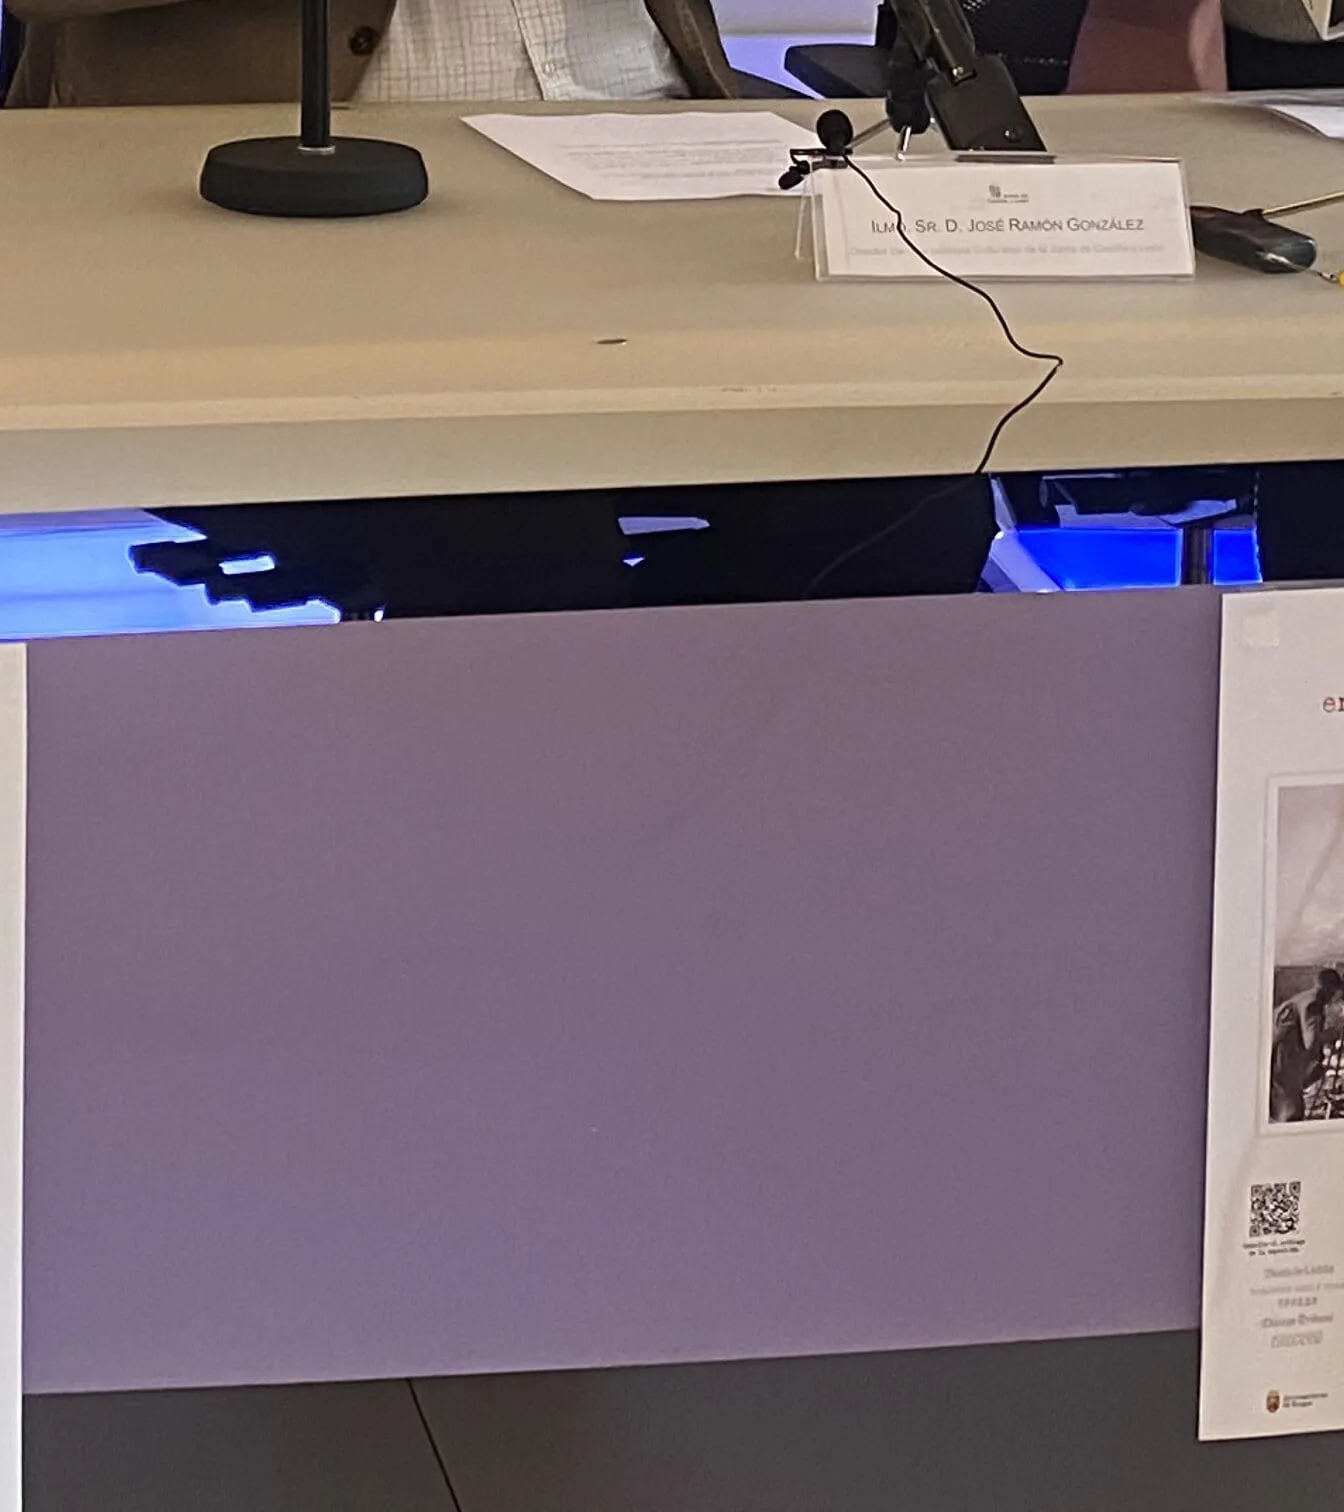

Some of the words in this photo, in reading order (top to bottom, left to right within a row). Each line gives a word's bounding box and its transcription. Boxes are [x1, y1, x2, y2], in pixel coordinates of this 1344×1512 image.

[967, 217, 1006, 233] JOSÉ
[1008, 217, 1063, 232] RAMÓN
[1066, 217, 1145, 232] GONZÁLEZ
